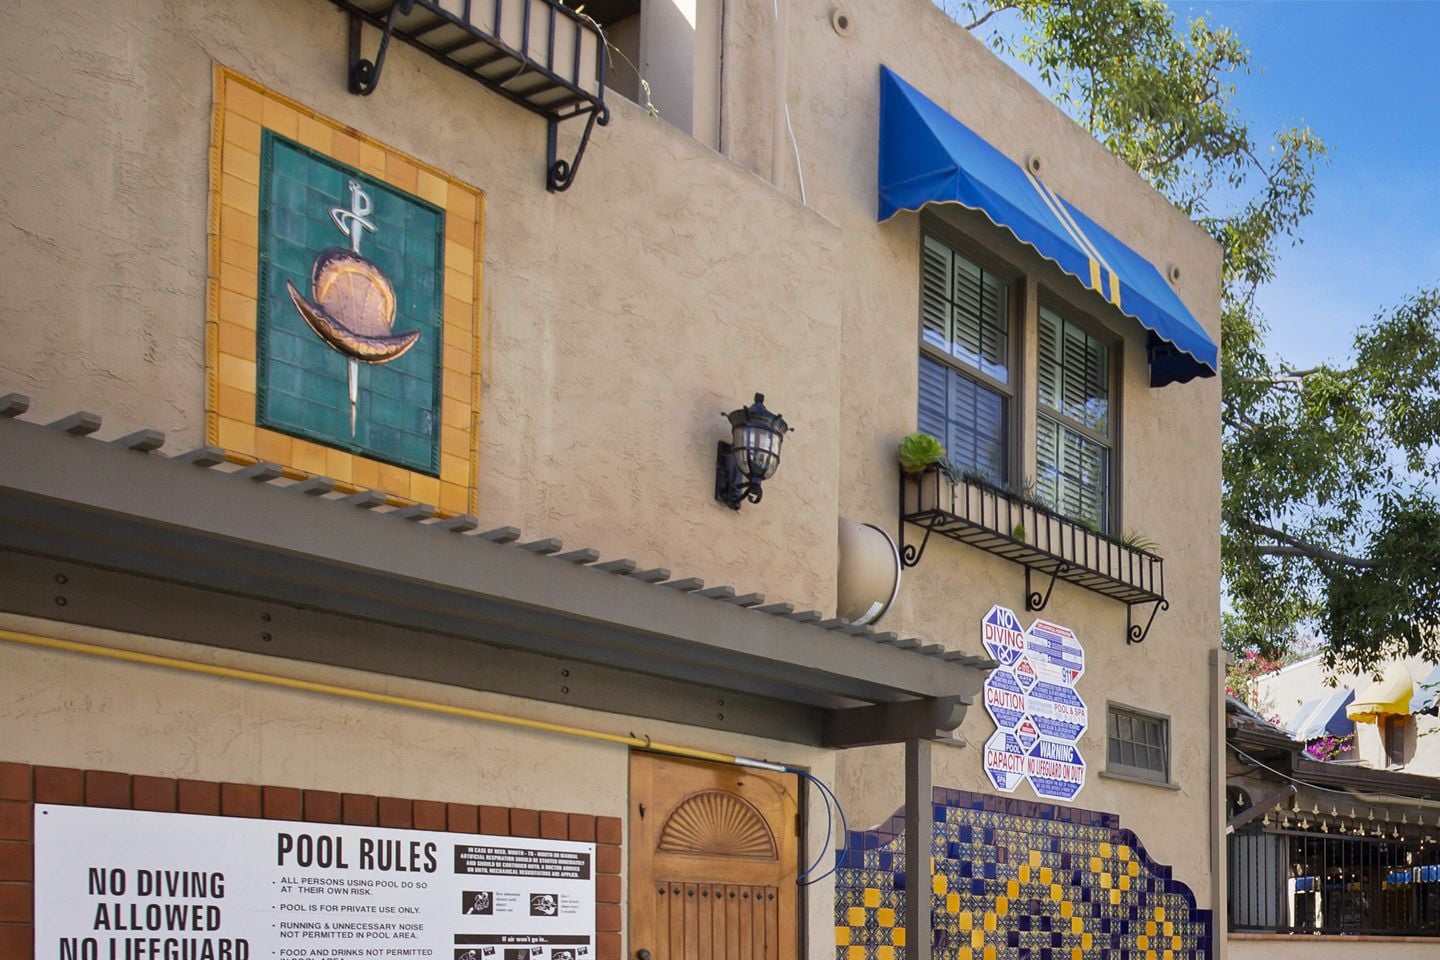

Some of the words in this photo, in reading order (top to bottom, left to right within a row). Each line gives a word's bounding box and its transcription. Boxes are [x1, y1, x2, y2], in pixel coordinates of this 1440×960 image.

[996, 608, 1013, 629] NO
[985, 623, 1024, 650] DIVING
[1062, 668, 1072, 683] 911
[987, 688, 1025, 710] CAUTION
[1054, 704, 1068, 713] POOL
[1006, 743, 1020, 753] POOL
[1040, 741, 1073, 762] WARNING
[987, 751, 1025, 772] CAPACITY
[1027, 758, 1034, 773] NO
[1036, 759, 1061, 778] LIFEGUARD
[1063, 764, 1070, 779] ON
[1072, 766, 1085, 782] DUTY
[278, 833, 349, 869] POOL
[360, 838, 437, 874] RULES
[88, 867, 126, 896] NO
[137, 869, 225, 899] DIVING
[281, 877, 299, 885] ALL
[301, 878, 345, 886] PERSONS
[347, 879, 374, 887] USING
[375, 880, 398, 888] POOL
[93, 903, 221, 931] ALLOWED
[280, 904, 306, 912] POOL
[309, 904, 317, 912] IS
[341, 905, 377, 913] PRIVATE
[280, 922, 322, 930] RUNNING
[325, 922, 330, 930] &
